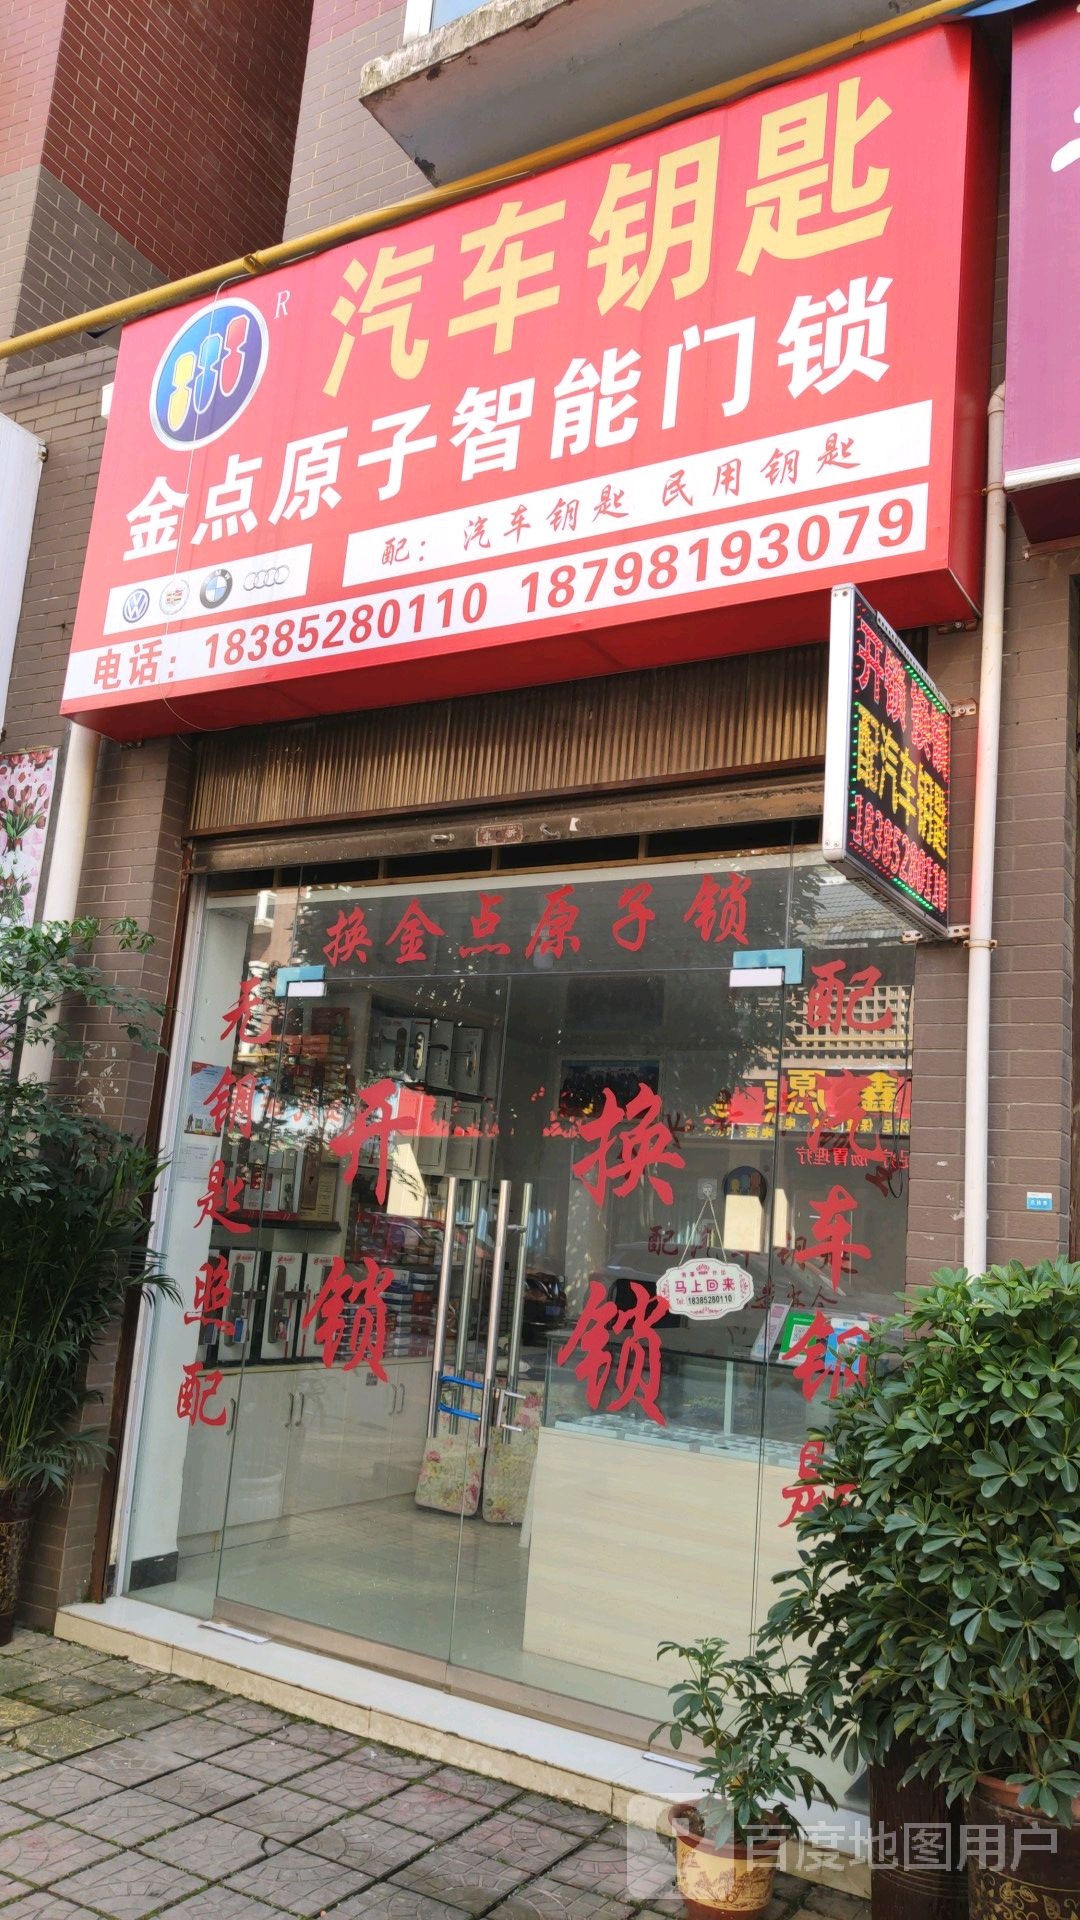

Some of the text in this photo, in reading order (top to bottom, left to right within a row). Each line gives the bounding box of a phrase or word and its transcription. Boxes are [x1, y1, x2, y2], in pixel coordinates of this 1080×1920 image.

[274, 291, 290, 319] R
[322, 76, 893, 397] 汽车钥匙
[122, 276, 893, 562] 金点原子智能门锁
[662, 432, 861, 509] 民用钥匙
[205, 582, 488, 669] 18385280110
[520, 497, 914, 614] 18798193079
[856, 702, 947, 860] 配汽车钥匙
[323, 872, 753, 968] 换金点原子锁
[302, 1077, 415, 1382] 开锁
[557, 1082, 686, 1427] 换锁
[675, 1277, 736, 1294] 马上回来
[688, 1295, 733, 1305] 18385280110
